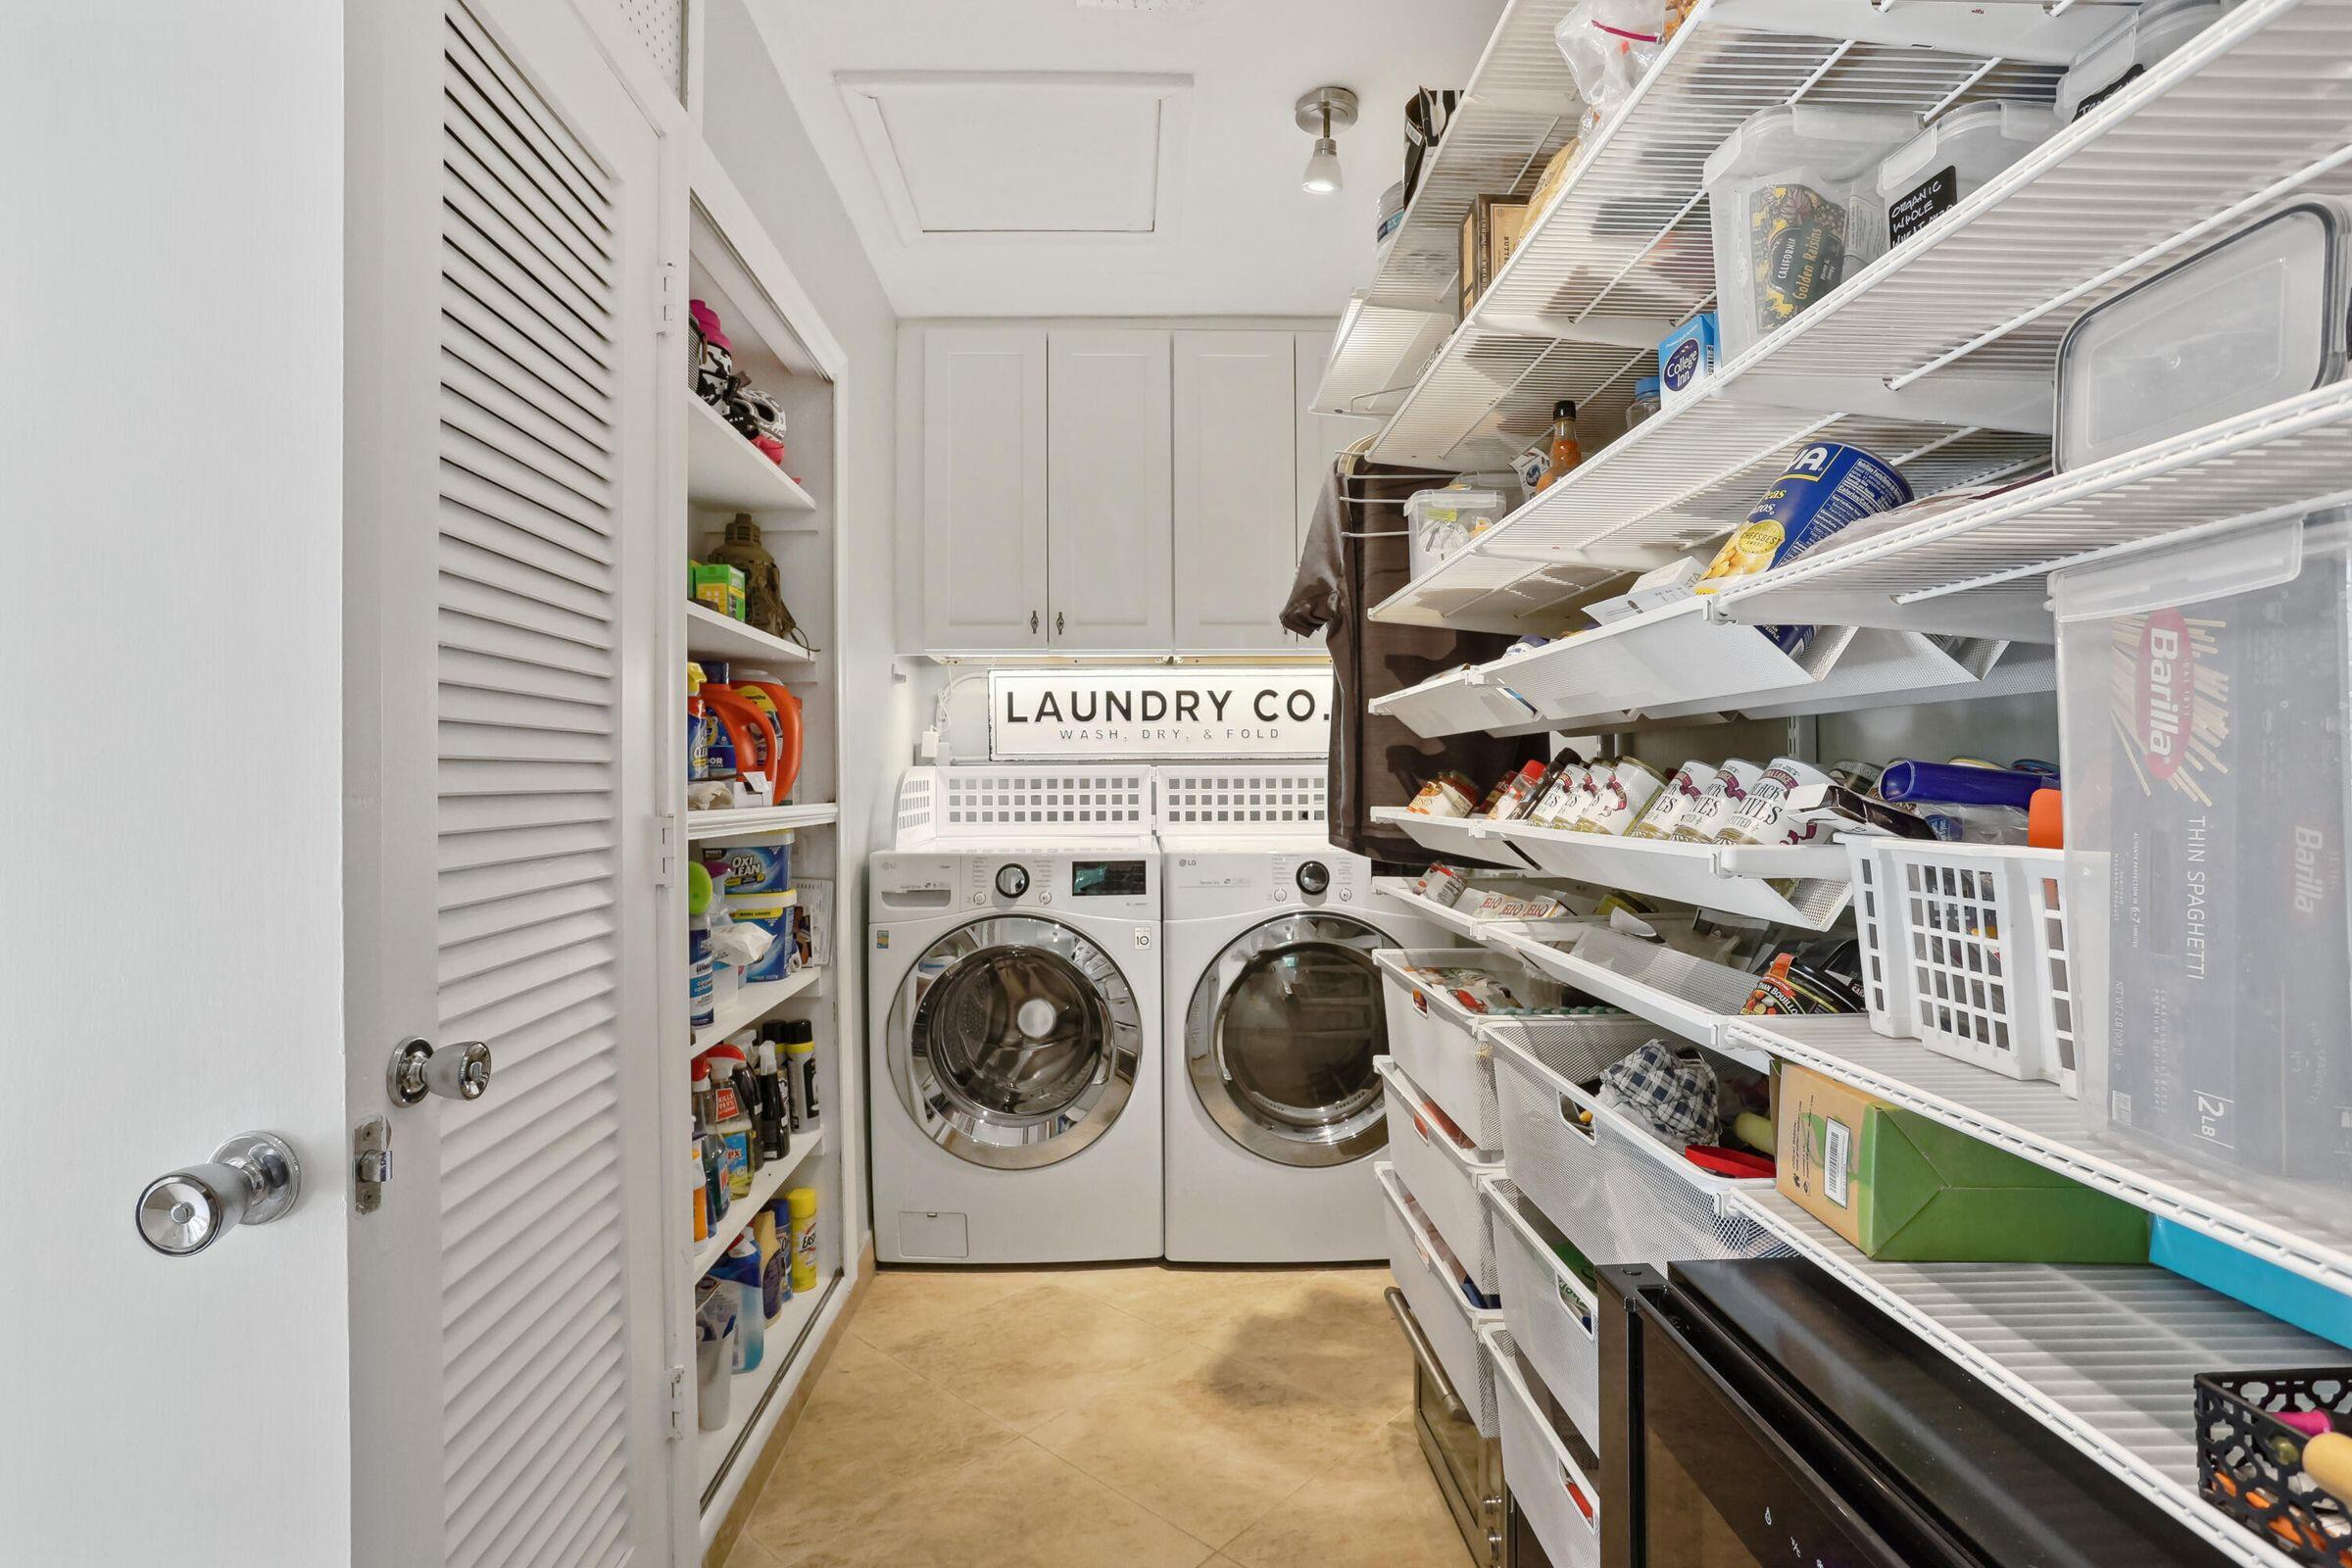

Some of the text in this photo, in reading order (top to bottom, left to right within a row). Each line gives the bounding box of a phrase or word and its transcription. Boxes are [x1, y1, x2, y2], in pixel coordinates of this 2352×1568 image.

[1892, 181, 1941, 218] ORGANIC
[1893, 200, 1934, 232] WHOLE
[1778, 237, 1796, 279] CALIFORNIA
[1791, 227, 1823, 300] Golden Raisins
[1667, 350, 1697, 377] College
[1677, 370, 1690, 387] Inn
[1007, 689, 1330, 722] LAUNDRY CO.
[2149, 627, 2180, 756] Barilla
[1059, 728, 1279, 741] WASH, DRY, & FOLD
[1752, 783, 1784, 803] LACK
[1734, 797, 1784, 825] LIVES
[732, 856, 754, 867] OXI
[733, 863, 760, 877] LEAN
[2294, 826, 2324, 914] Barilla
[2186, 814, 2207, 980] THIN SPAGHETTI
[1772, 987, 1799, 1014] BOUILLO
